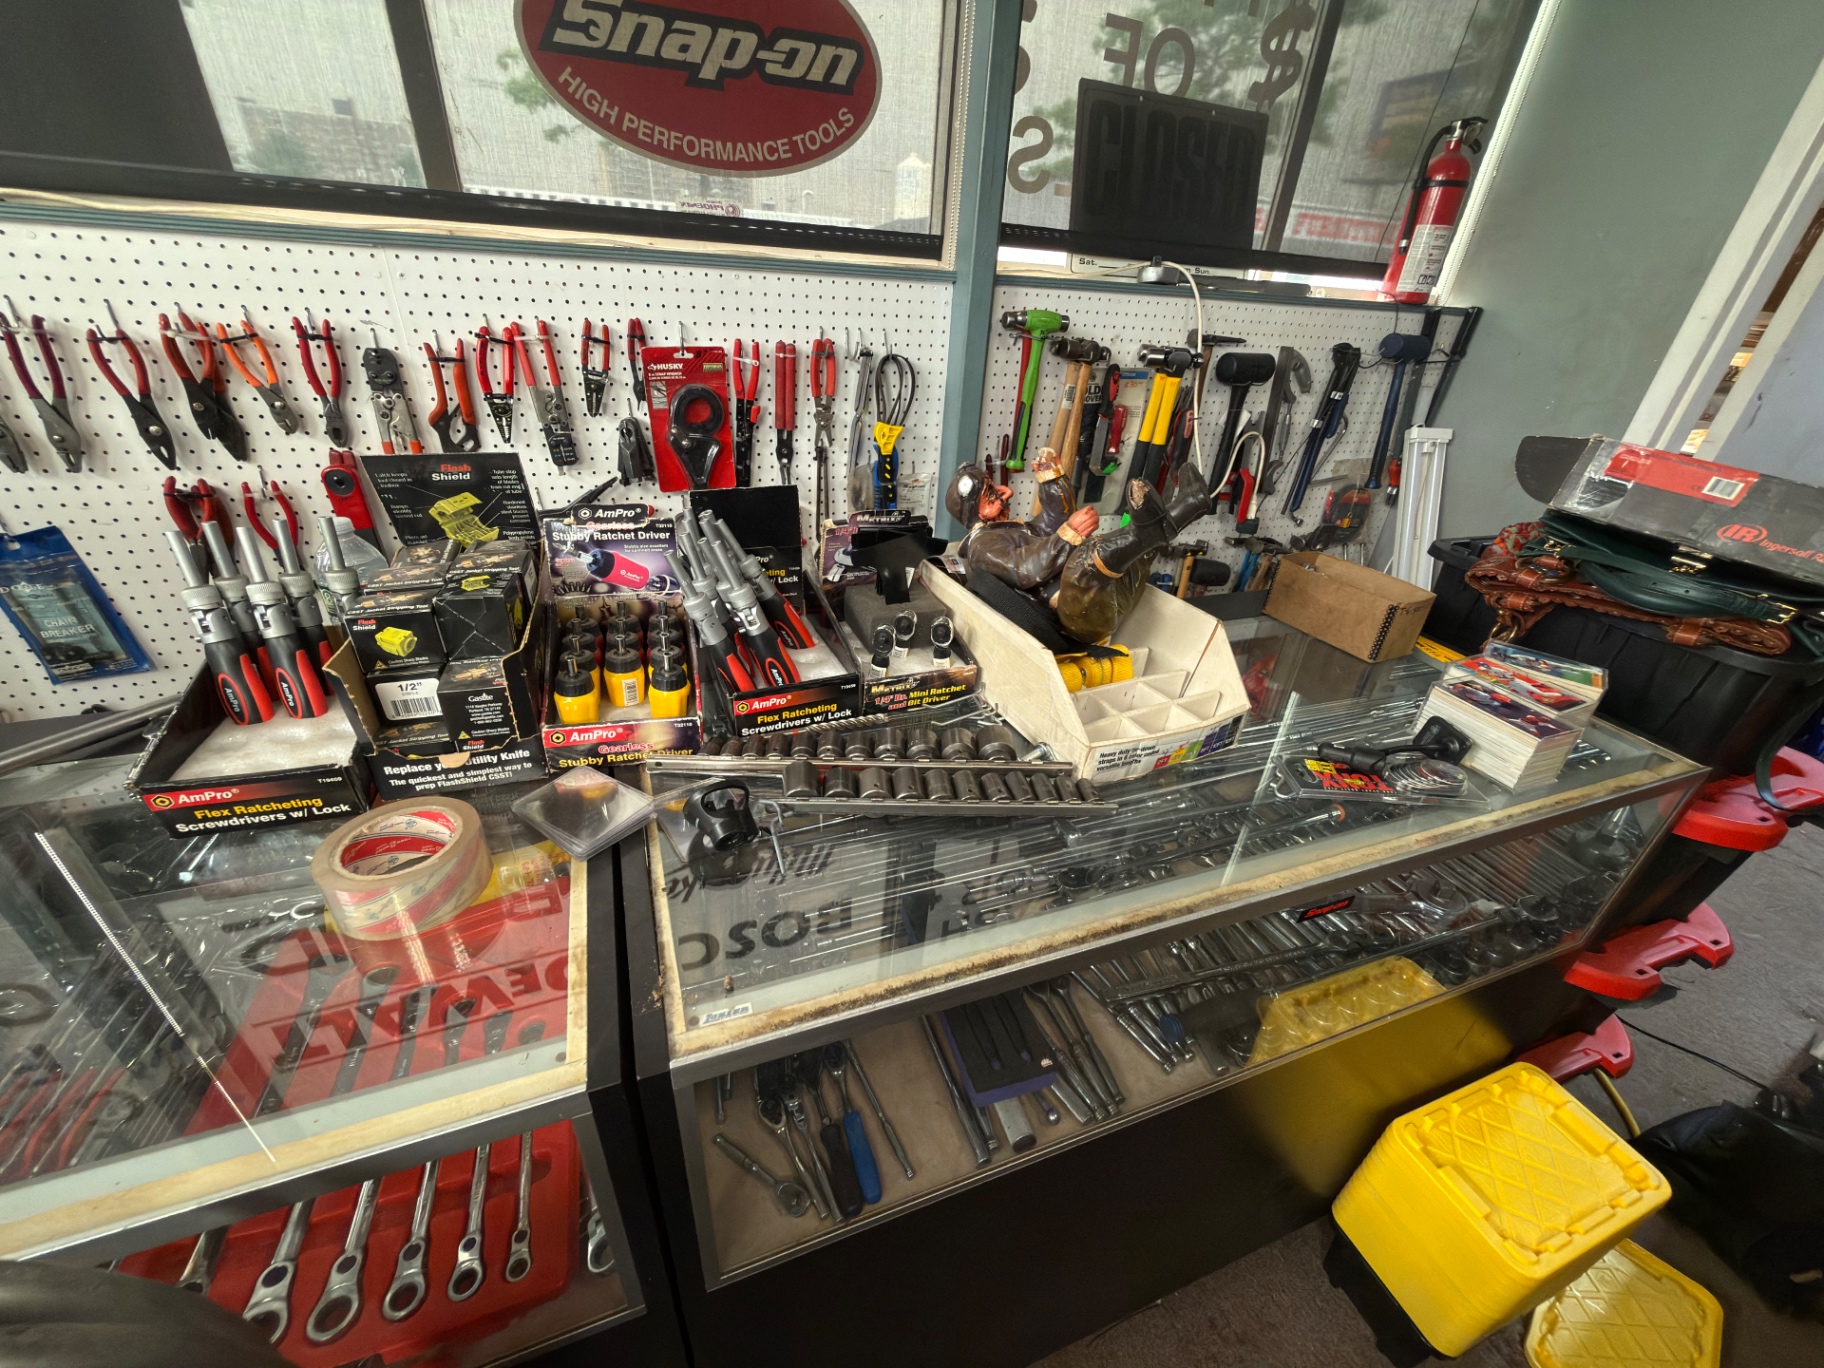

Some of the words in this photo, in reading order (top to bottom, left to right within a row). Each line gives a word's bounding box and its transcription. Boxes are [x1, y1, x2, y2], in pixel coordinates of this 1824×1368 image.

[553, 0, 859, 86] Snap-on
[558, 66, 618, 126] HIGH
[622, 112, 792, 163] PERFORMANCE
[793, 107, 855, 155] TOOLS
[1079, 257, 1097, 266] Sat.
[431, 472, 471, 481] Shield
[440, 463, 472, 472] Flash
[552, 532, 590, 542] Stubby
[593, 532, 636, 541] Ratchet
[638, 531, 671, 540] Driver
[1722, 524, 1760, 542] IR
[1760, 539, 1815, 559] Ingersoll
[778, 575, 799, 583] Lock
[40, 624, 96, 638] BREAKER
[43, 617, 78, 627] CHAIN
[224, 687, 241, 713] AmPro
[281, 682, 295, 707] AmPro
[909, 690, 929, 698] Mini
[930, 684, 967, 695] Ratchet
[887, 701, 907, 710] and
[922, 695, 951, 704] Driver
[741, 717, 811, 736] Screwdrivers
[813, 714, 825, 722] w/
[828, 709, 852, 719] Lock
[757, 714, 779, 724] Flex
[782, 703, 838, 719] Ratcheting
[598, 743, 654, 754] Gearless
[383, 761, 432, 776] Replace
[500, 750, 530, 762] Knife
[559, 757, 604, 769] Stubby
[607, 750, 653, 763] Ratchet
[1098, 758, 1116, 766] straps
[389, 778, 406, 787] The
[409, 773, 446, 785] quickest
[465, 768, 502, 779] simplest
[504, 764, 522, 773] way
[415, 783, 435, 791] prep
[437, 776, 487, 788] FlashShield
[489, 772, 513, 780] CSST!
[175, 812, 287, 833] Screwdrivers
[289, 808, 308, 818] w/
[312, 803, 351, 815] Lock
[193, 807, 230, 820] Flex
[233, 798, 324, 815] Ratcheting
